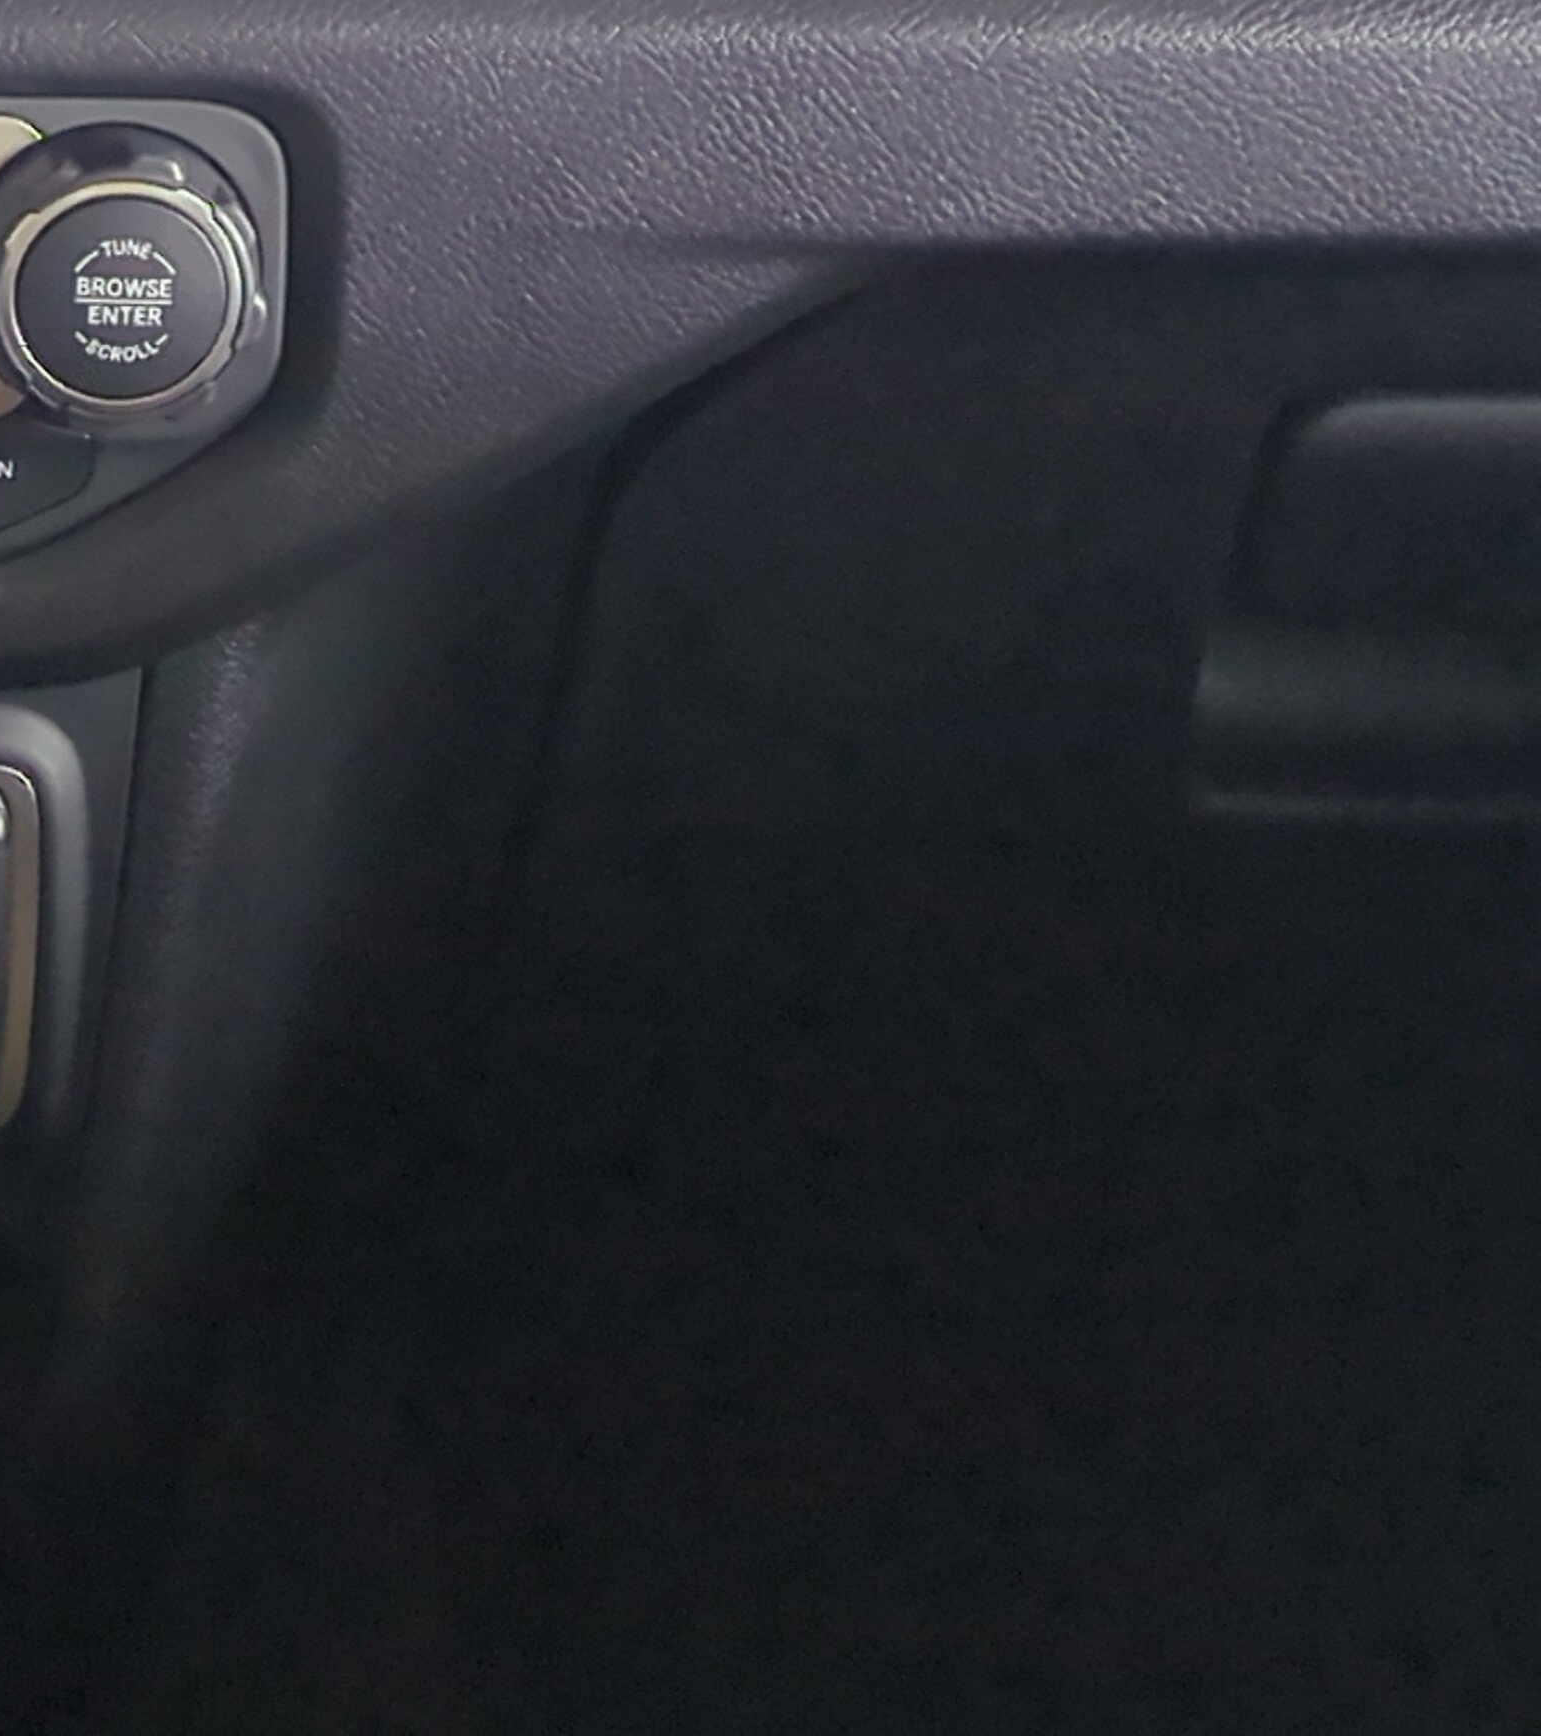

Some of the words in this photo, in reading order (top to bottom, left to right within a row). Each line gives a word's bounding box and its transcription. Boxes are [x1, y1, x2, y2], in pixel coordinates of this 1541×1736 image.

[100, 238, 153, 260] TUNE
[75, 276, 173, 298] BROWSE
[87, 306, 163, 326] ENTER
[85, 338, 159, 363] SCROLL
